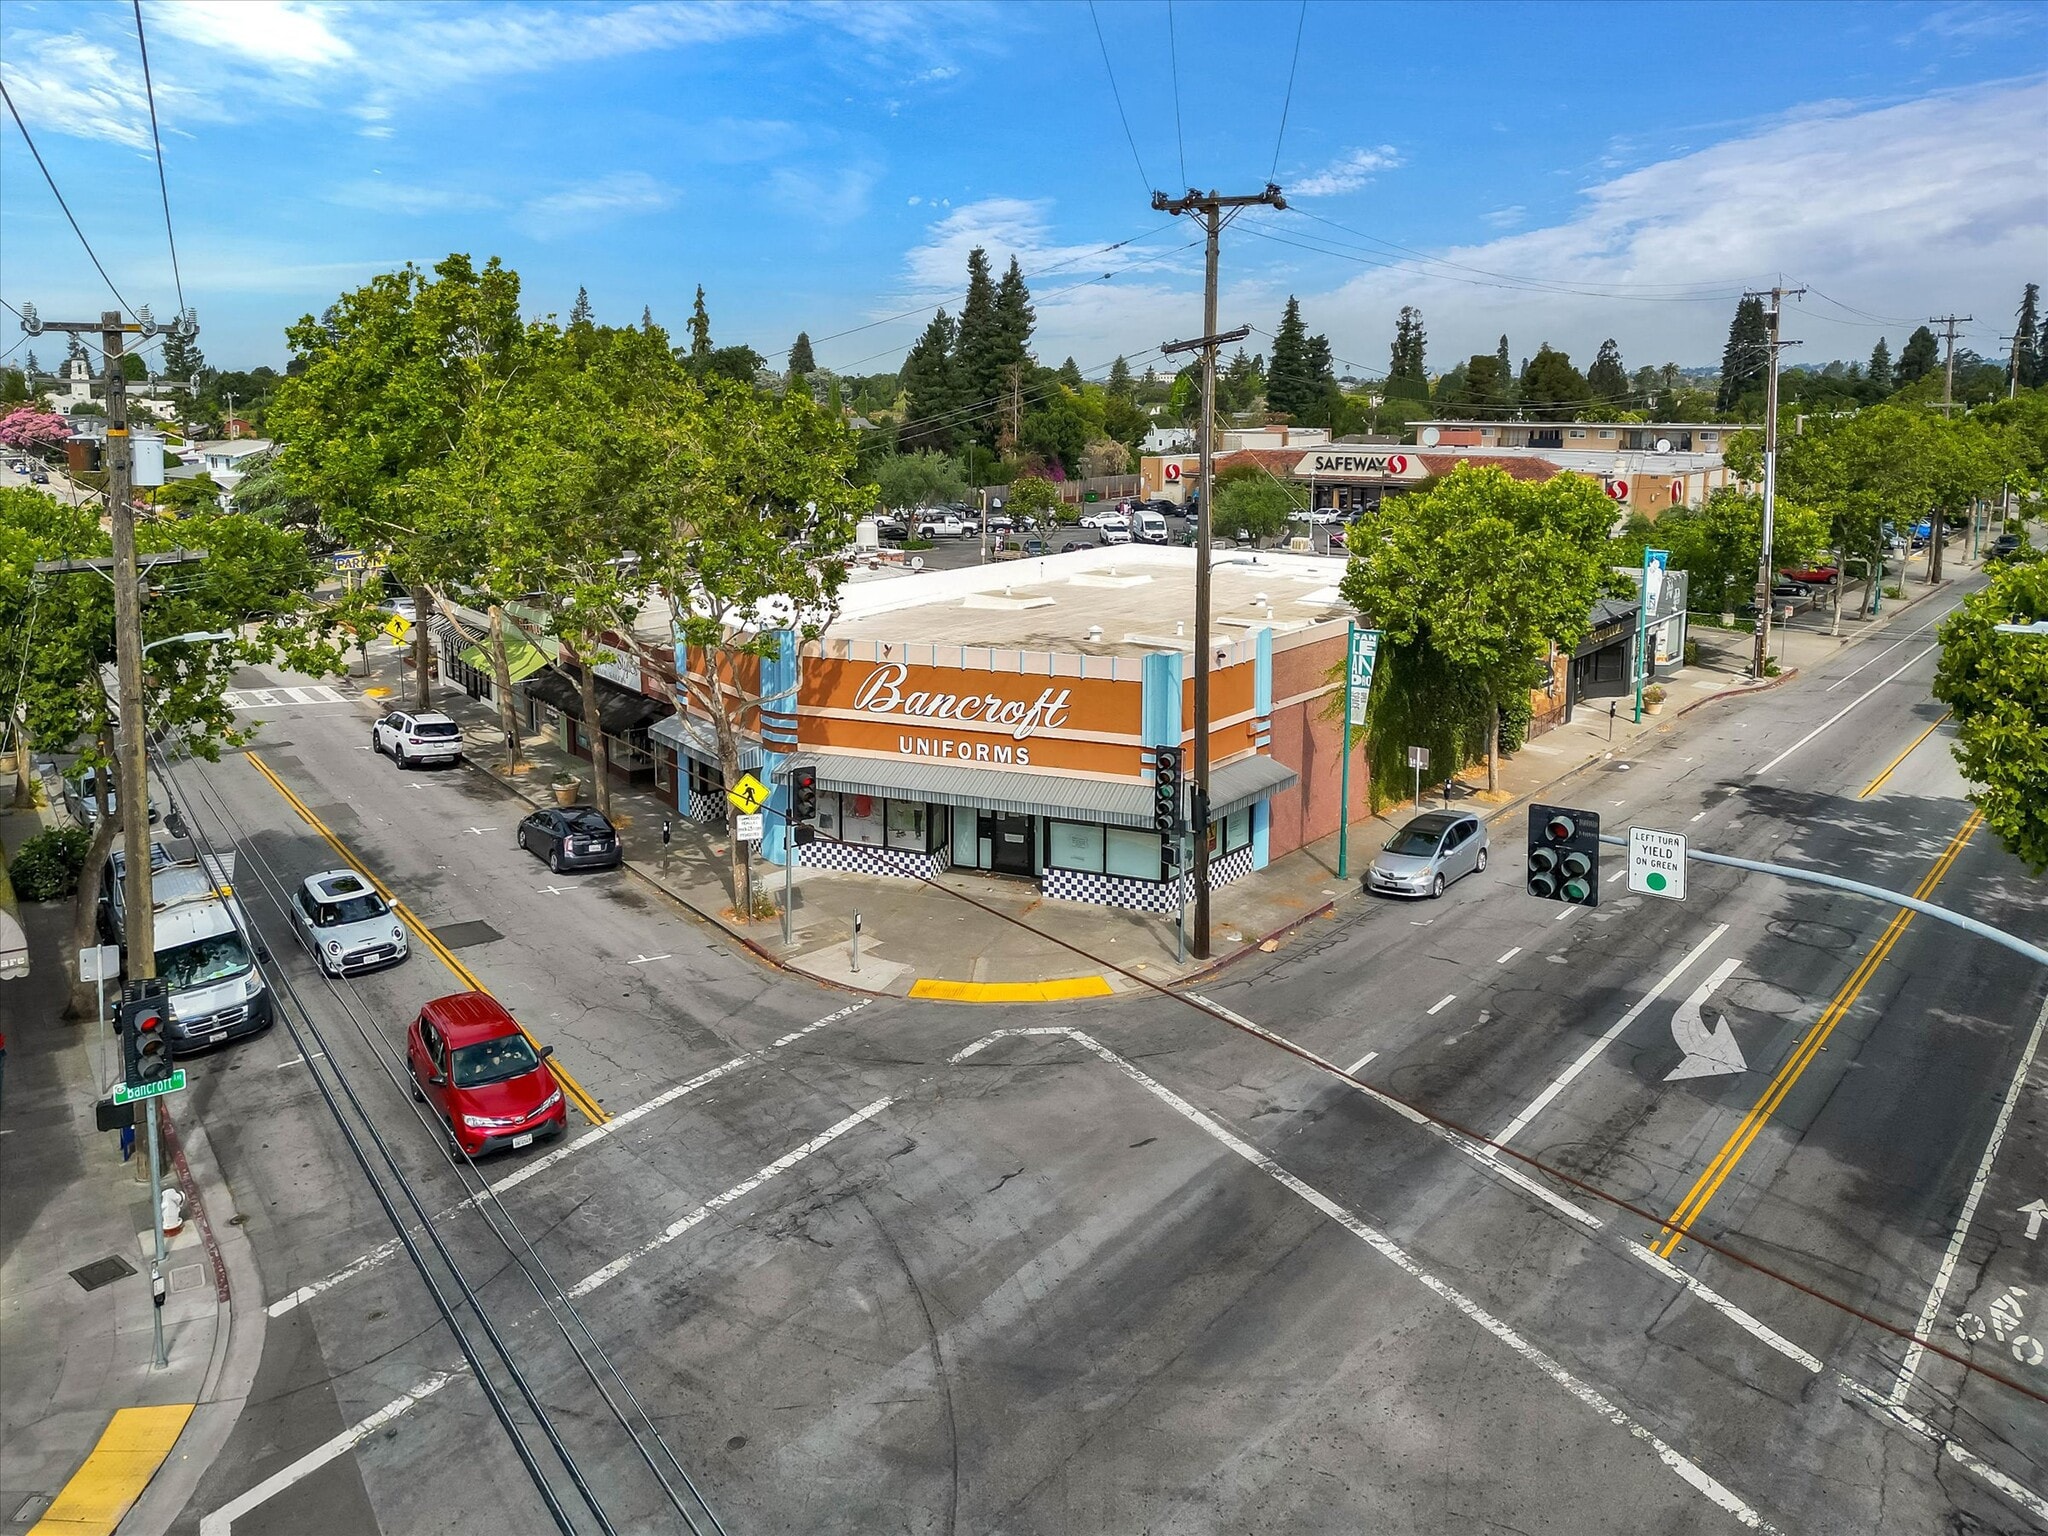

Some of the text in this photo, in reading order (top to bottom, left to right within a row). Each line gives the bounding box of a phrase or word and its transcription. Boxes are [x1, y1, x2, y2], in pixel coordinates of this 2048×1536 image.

[1315, 456, 1386, 471] SAFEWAY
[1353, 632, 1377, 641] SAN
[854, 663, 1073, 740] Bancroft
[899, 735, 1031, 765] UNIFORMS
[1635, 832, 1680, 847] LEFT TURN
[1642, 845, 1673, 859] YIELD
[1636, 857, 1678, 871] ON GREEN
[127, 1078, 173, 1099] Bancroft
